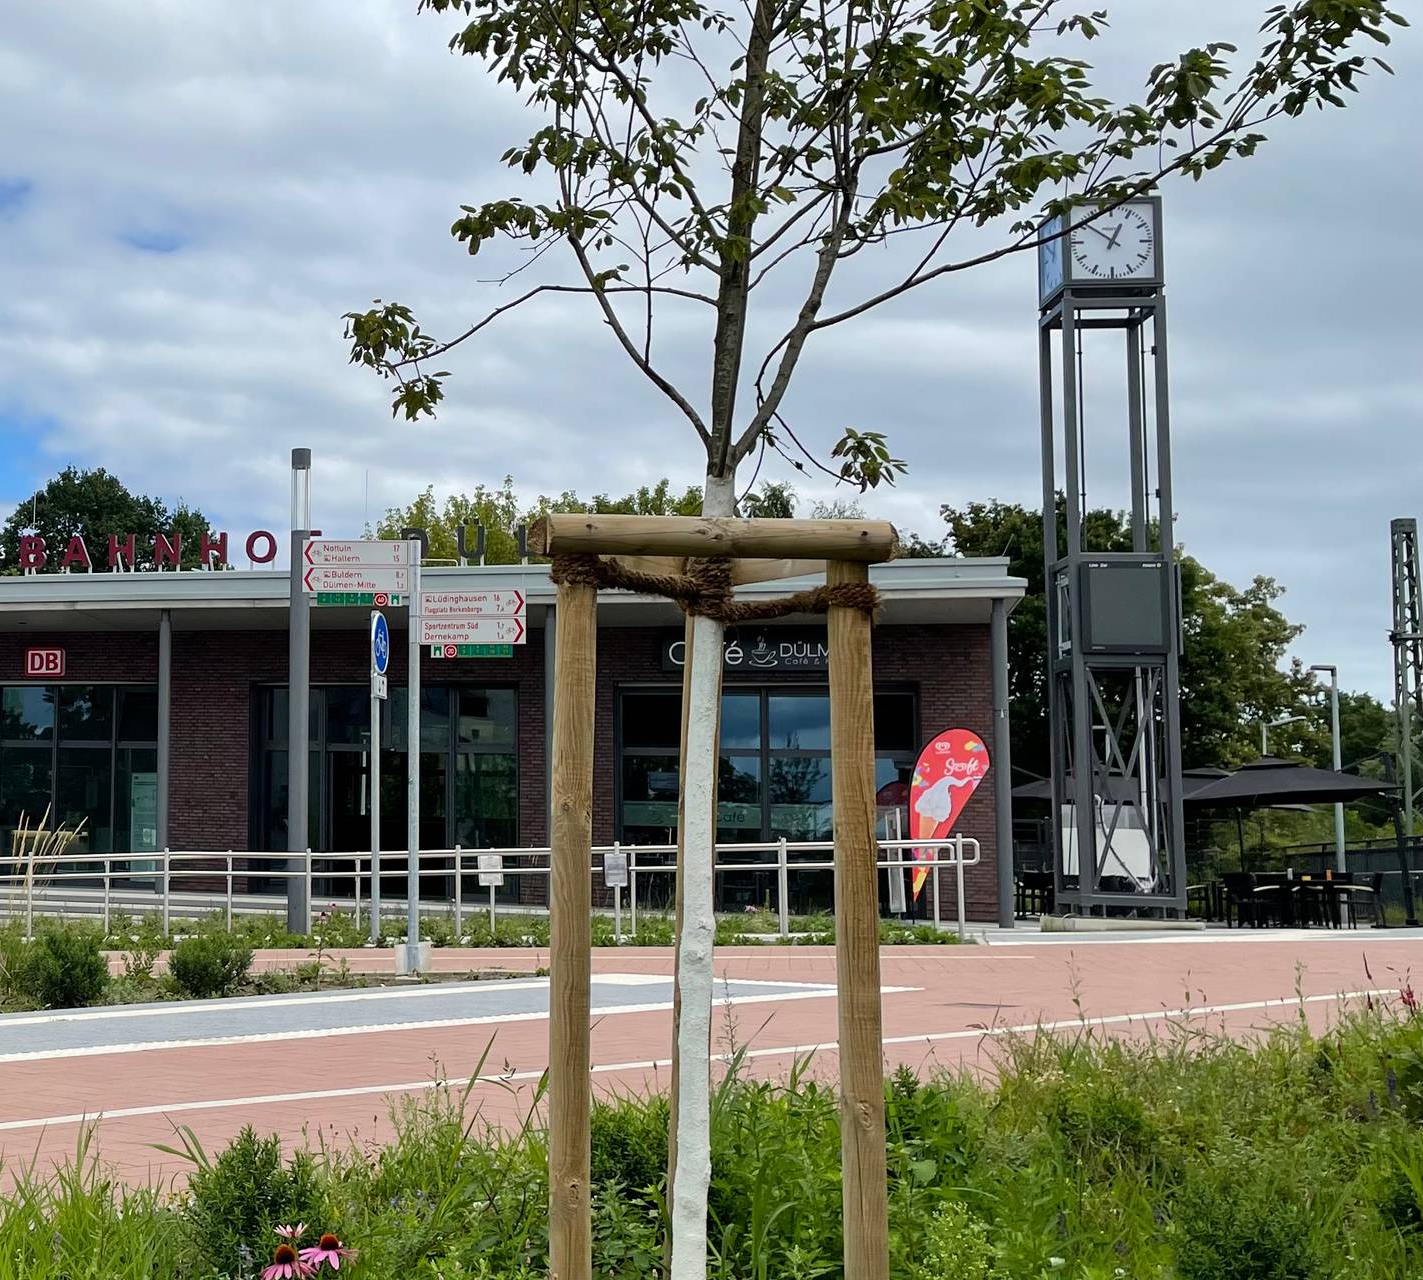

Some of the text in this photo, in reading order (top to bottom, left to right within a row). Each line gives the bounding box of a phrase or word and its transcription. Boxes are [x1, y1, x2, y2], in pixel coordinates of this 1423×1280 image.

[20, 530, 322, 568] BAHNHO
[331, 570, 362, 579] Buldern
[323, 580, 376, 589] Dülmen-Mitte
[432, 593, 487, 604] Lüdinghausen
[424, 621, 479, 631] Sportzentrum Süd
[424, 632, 470, 641] Dernekamp
[669, 640, 744, 665] Cé
[780, 641, 830, 657] DÜLM
[29, 652, 59, 672] DB
[784, 657, 809, 665] Café
